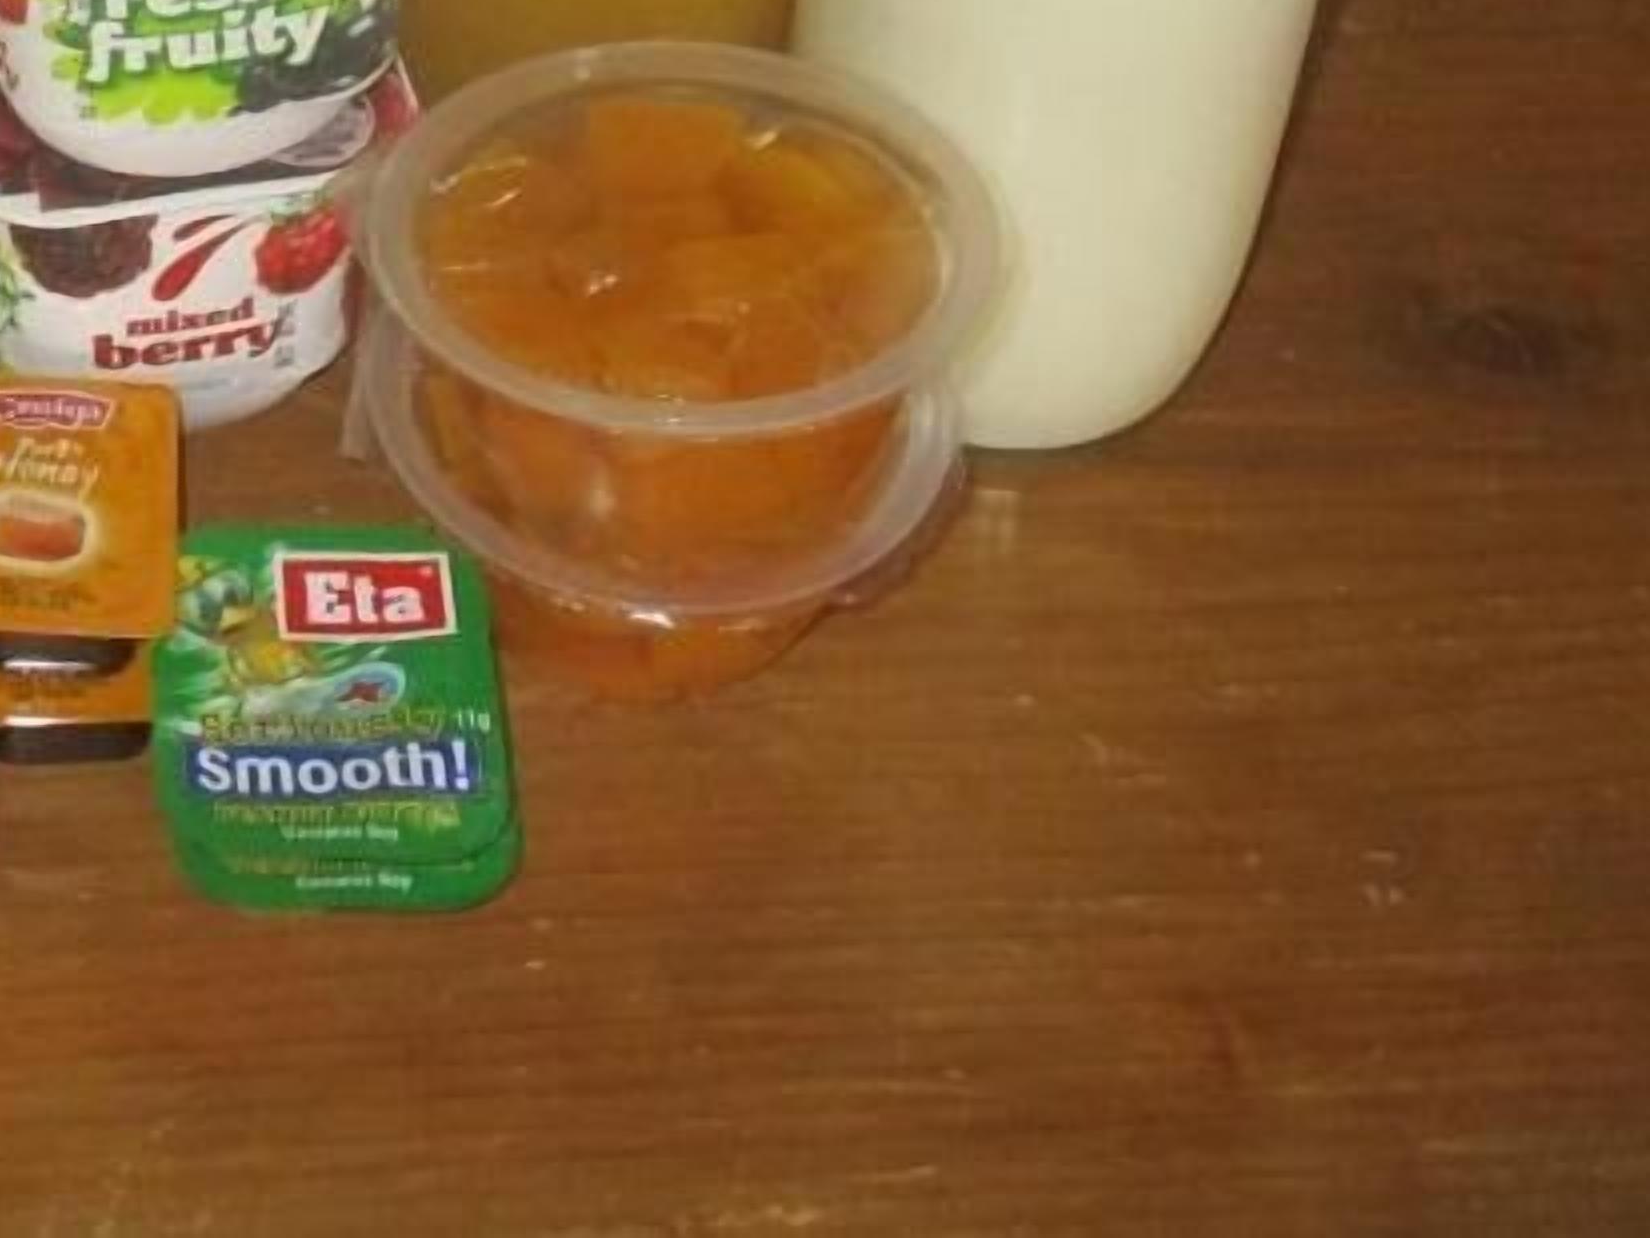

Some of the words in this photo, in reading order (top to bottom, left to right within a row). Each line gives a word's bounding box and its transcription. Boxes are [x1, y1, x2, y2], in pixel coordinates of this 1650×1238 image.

[86, 4, 330, 84] fruity
[91, 312, 284, 370] berry
[126, 297, 254, 337] mixed
[303, 571, 425, 624] Eta
[198, 737, 469, 795] Smooth!
